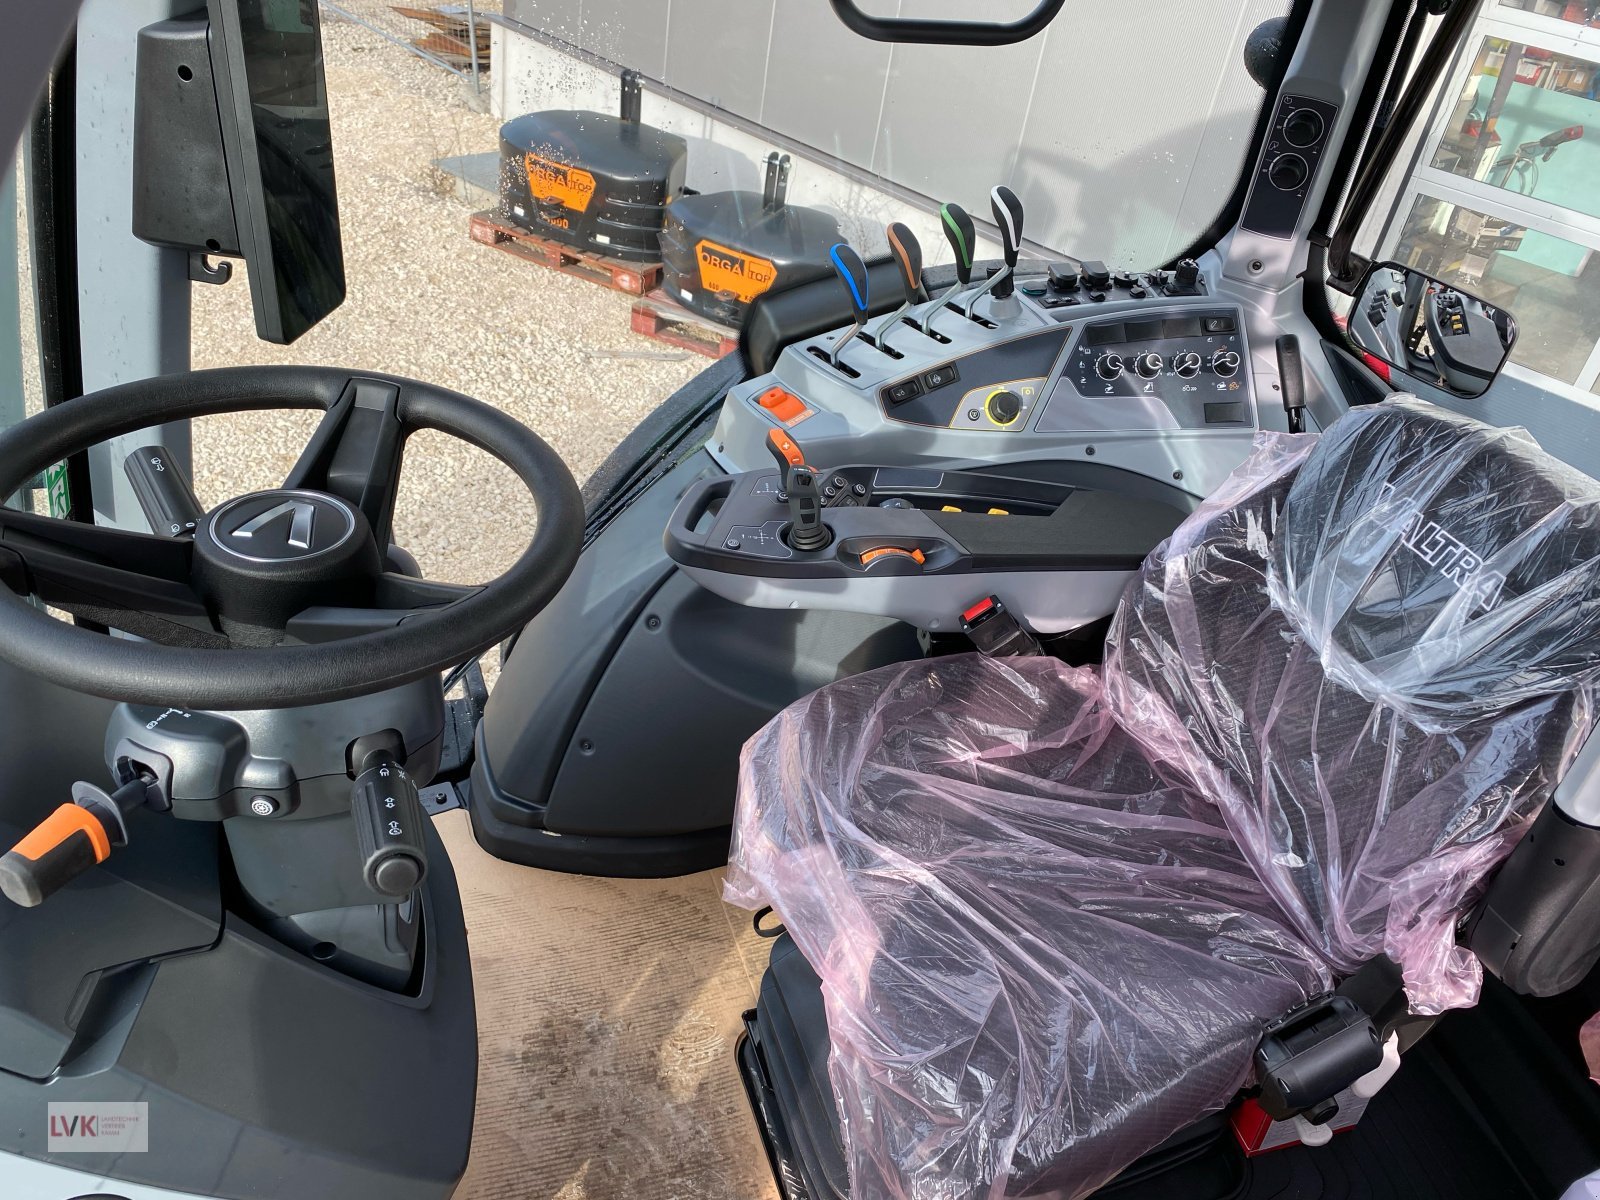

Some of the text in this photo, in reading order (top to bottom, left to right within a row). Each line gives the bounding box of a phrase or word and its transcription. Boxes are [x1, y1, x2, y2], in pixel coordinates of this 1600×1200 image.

[571, 180, 593, 193] TOP
[702, 251, 771, 283] ORGA TOP
